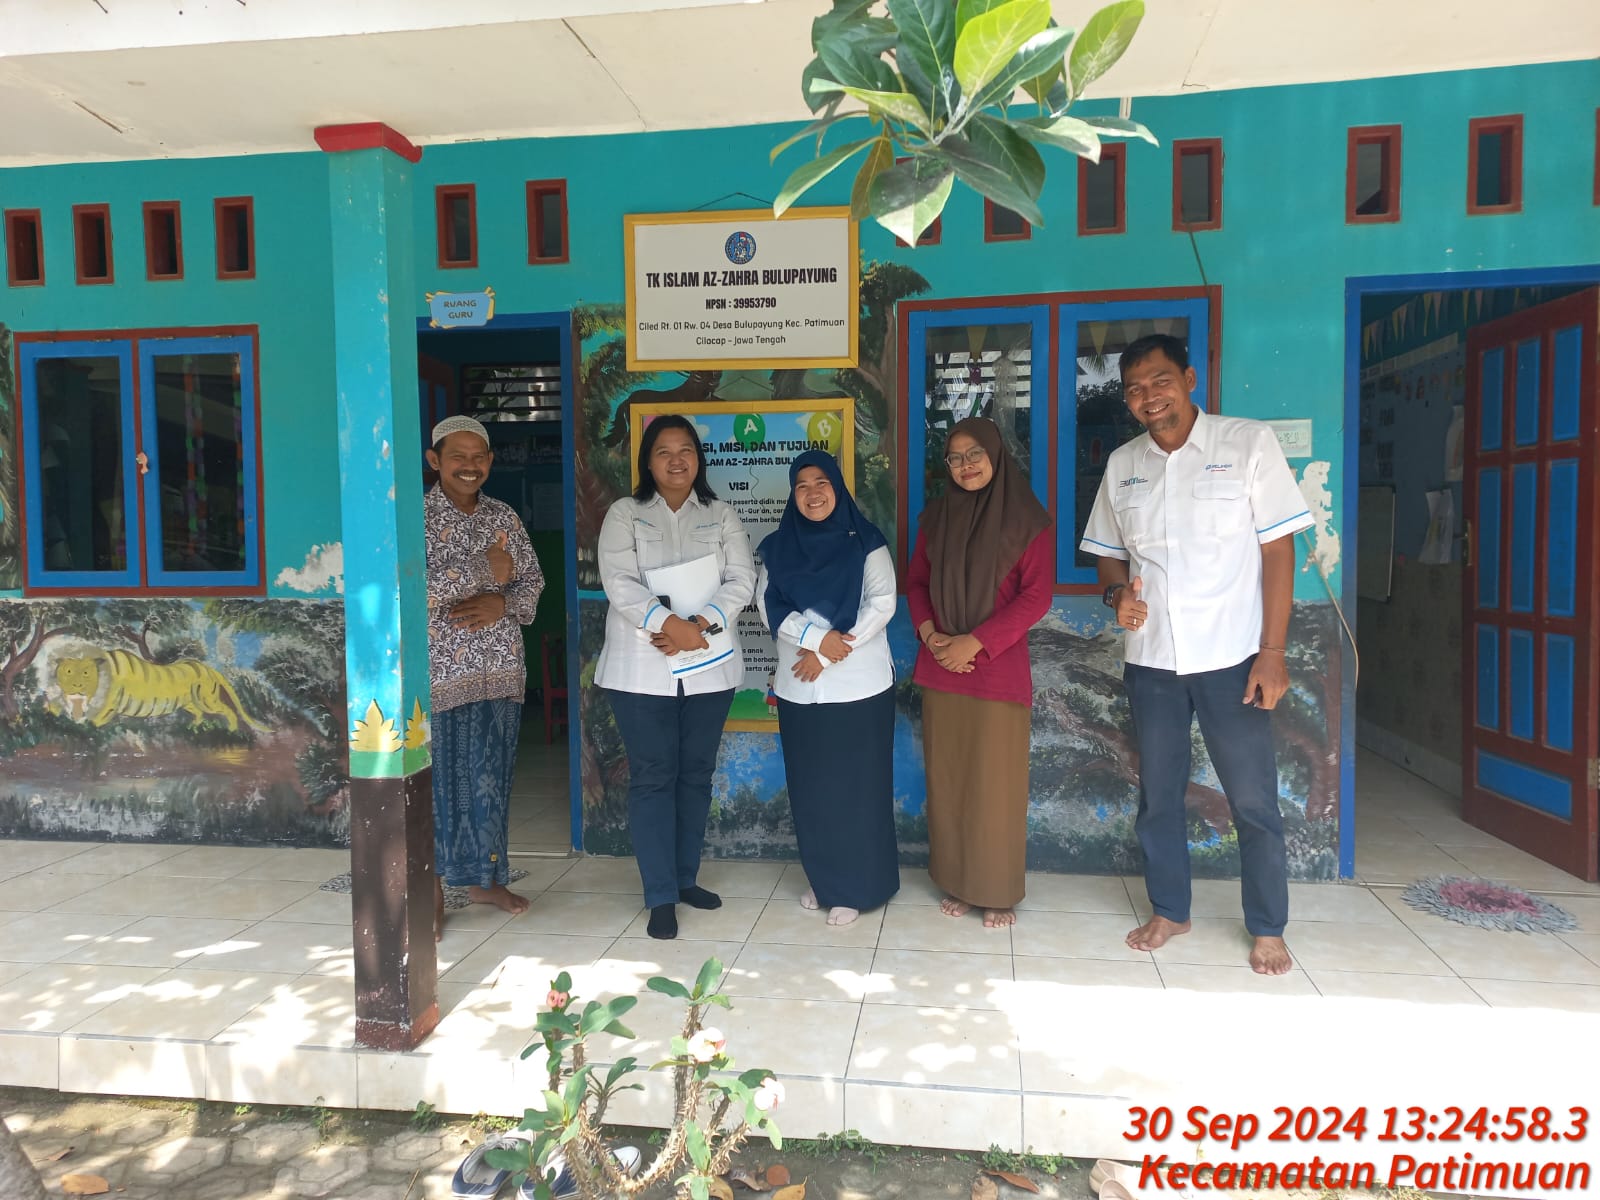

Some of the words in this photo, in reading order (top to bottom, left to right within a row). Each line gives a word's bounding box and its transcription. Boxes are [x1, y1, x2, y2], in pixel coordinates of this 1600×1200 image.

[646, 273, 660, 288] TK
[663, 272, 699, 287] ISLAM
[703, 270, 759, 286] AZ-ZAHRA
[762, 267, 837, 285] BULUPAYUNG
[444, 299, 477, 308] RUANG
[706, 298, 726, 309] NPSN
[733, 297, 777, 308] 39953790
[448, 311, 473, 319] GURU
[639, 321, 658, 331] Ciled
[661, 321, 672, 330] Rt.
[673, 321, 682, 330] 01
[684, 320, 698, 330] Rw.
[700, 320, 711, 330] 04
[713, 320, 732, 329] Desa
[735, 319, 783, 331] Bulupayung
[786, 319, 803, 328] Kec.
[804, 318, 845, 327] Patimuan
[696, 336, 726, 347] Cilacap
[733, 336, 753, 346] Jawa
[756, 335, 786, 346] Tengah
[744, 418, 758, 435] A
[817, 419, 832, 438] B
[702, 442, 717, 454] SI,
[719, 441, 748, 454] MISI,
[750, 441, 777, 451] DAN
[778, 440, 829, 451] TUJUAN
[725, 457, 774, 466] AZ-ZAHRA
[728, 482, 749, 491] VISI
